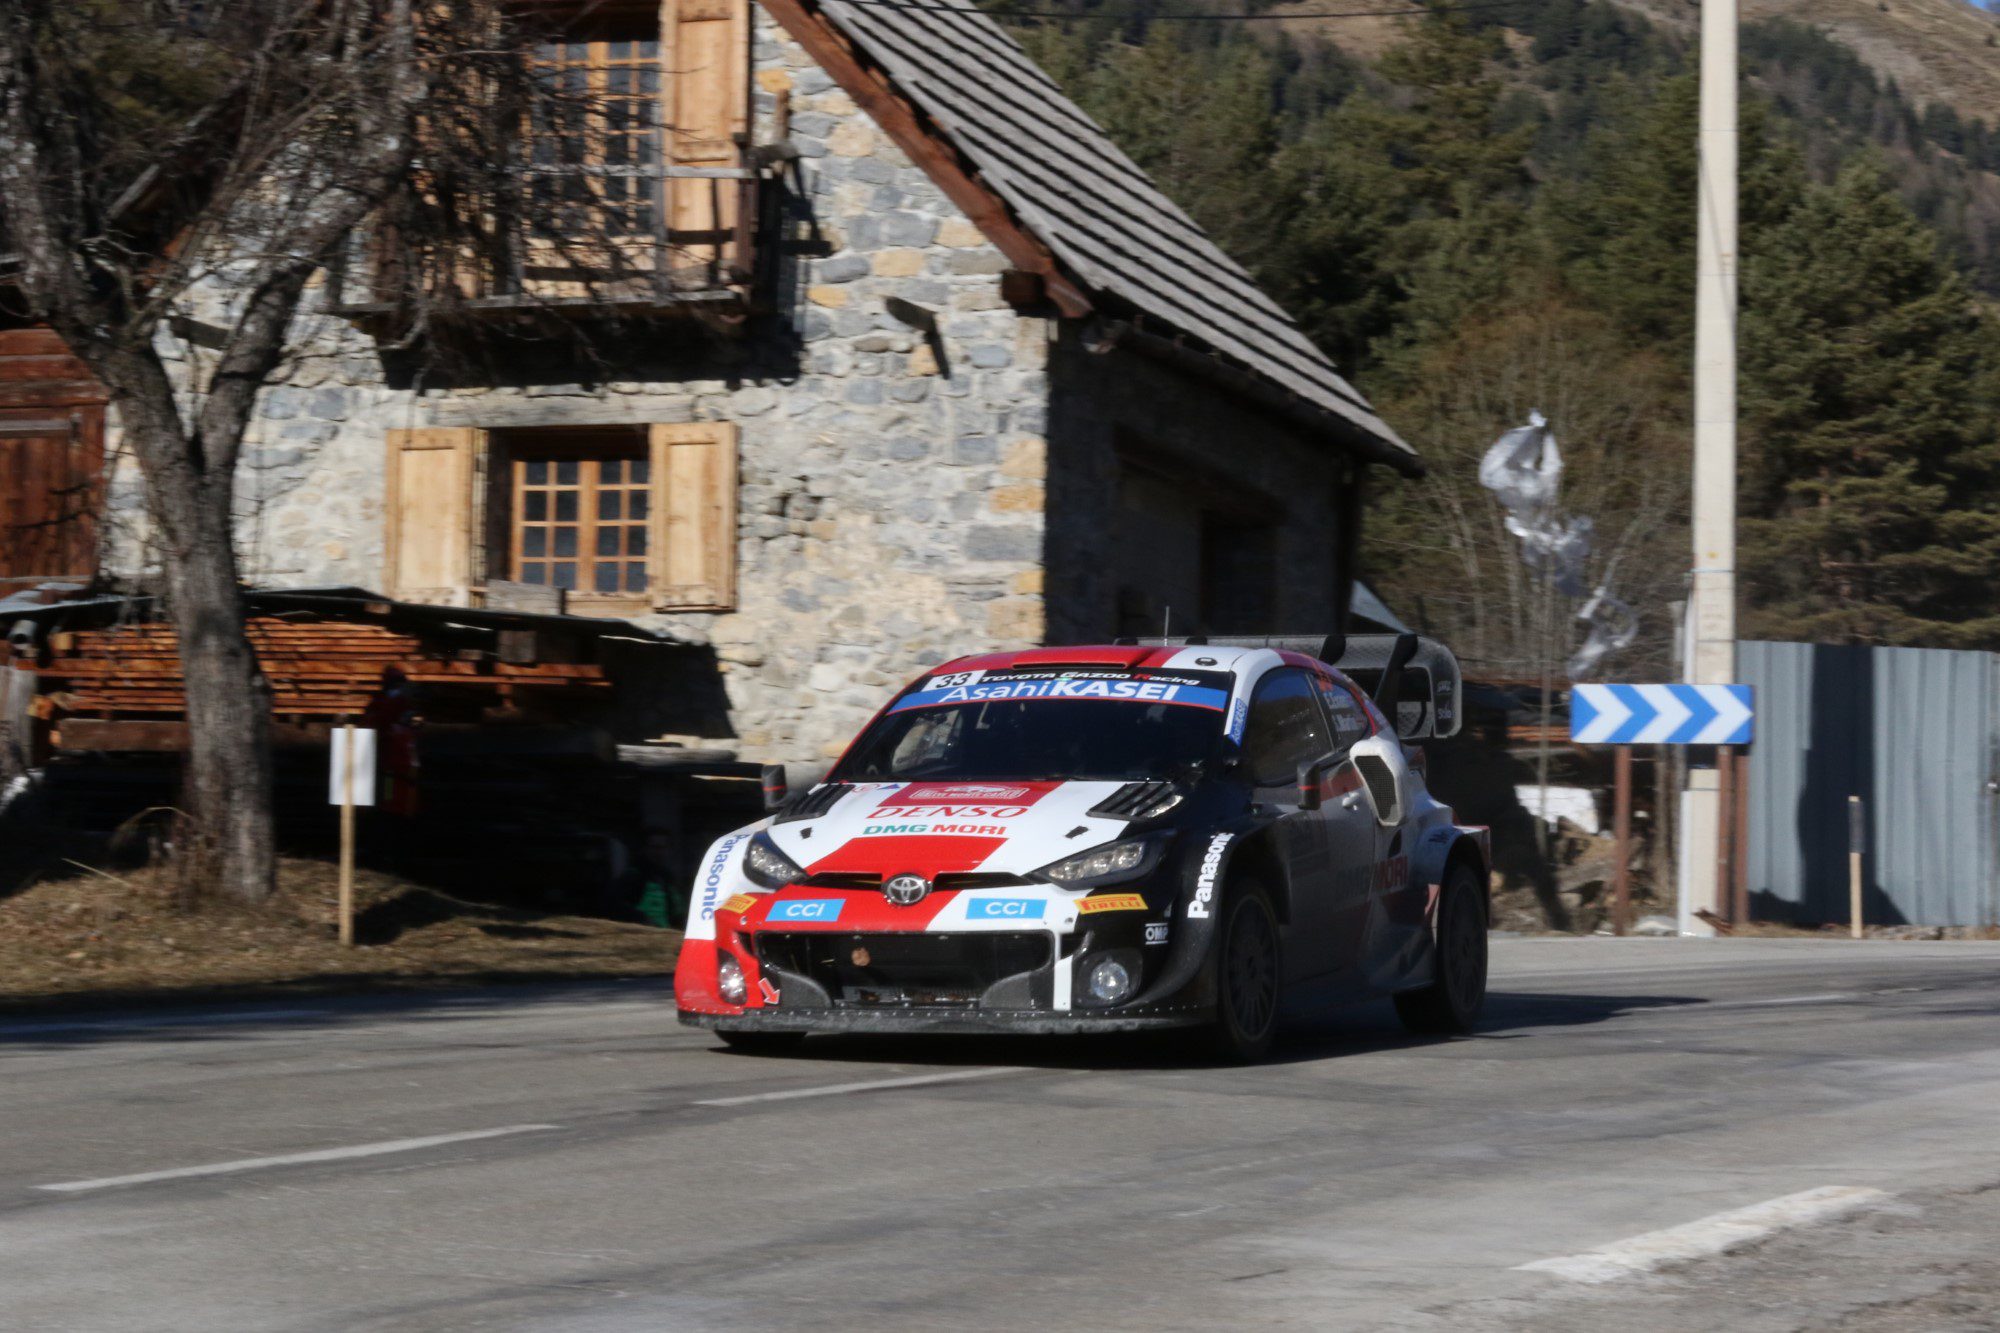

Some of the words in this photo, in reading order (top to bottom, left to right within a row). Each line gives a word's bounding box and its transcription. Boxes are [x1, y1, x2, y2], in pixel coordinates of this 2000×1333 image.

[936, 673, 973, 689] 33
[982, 672, 1056, 683] TOYOTA
[1060, 671, 1131, 680] GAZOO
[1133, 672, 1201, 686] Racing
[866, 806, 1029, 819] DENSO
[862, 824, 928, 835] DMG
[931, 824, 1008, 835] MORI
[701, 833, 751, 921] Panasonic
[785, 903, 825, 917] CCI
[984, 901, 1027, 916] CCI
[1079, 896, 1142, 911] PIRELLI
[1145, 926, 1169, 941] OMP
